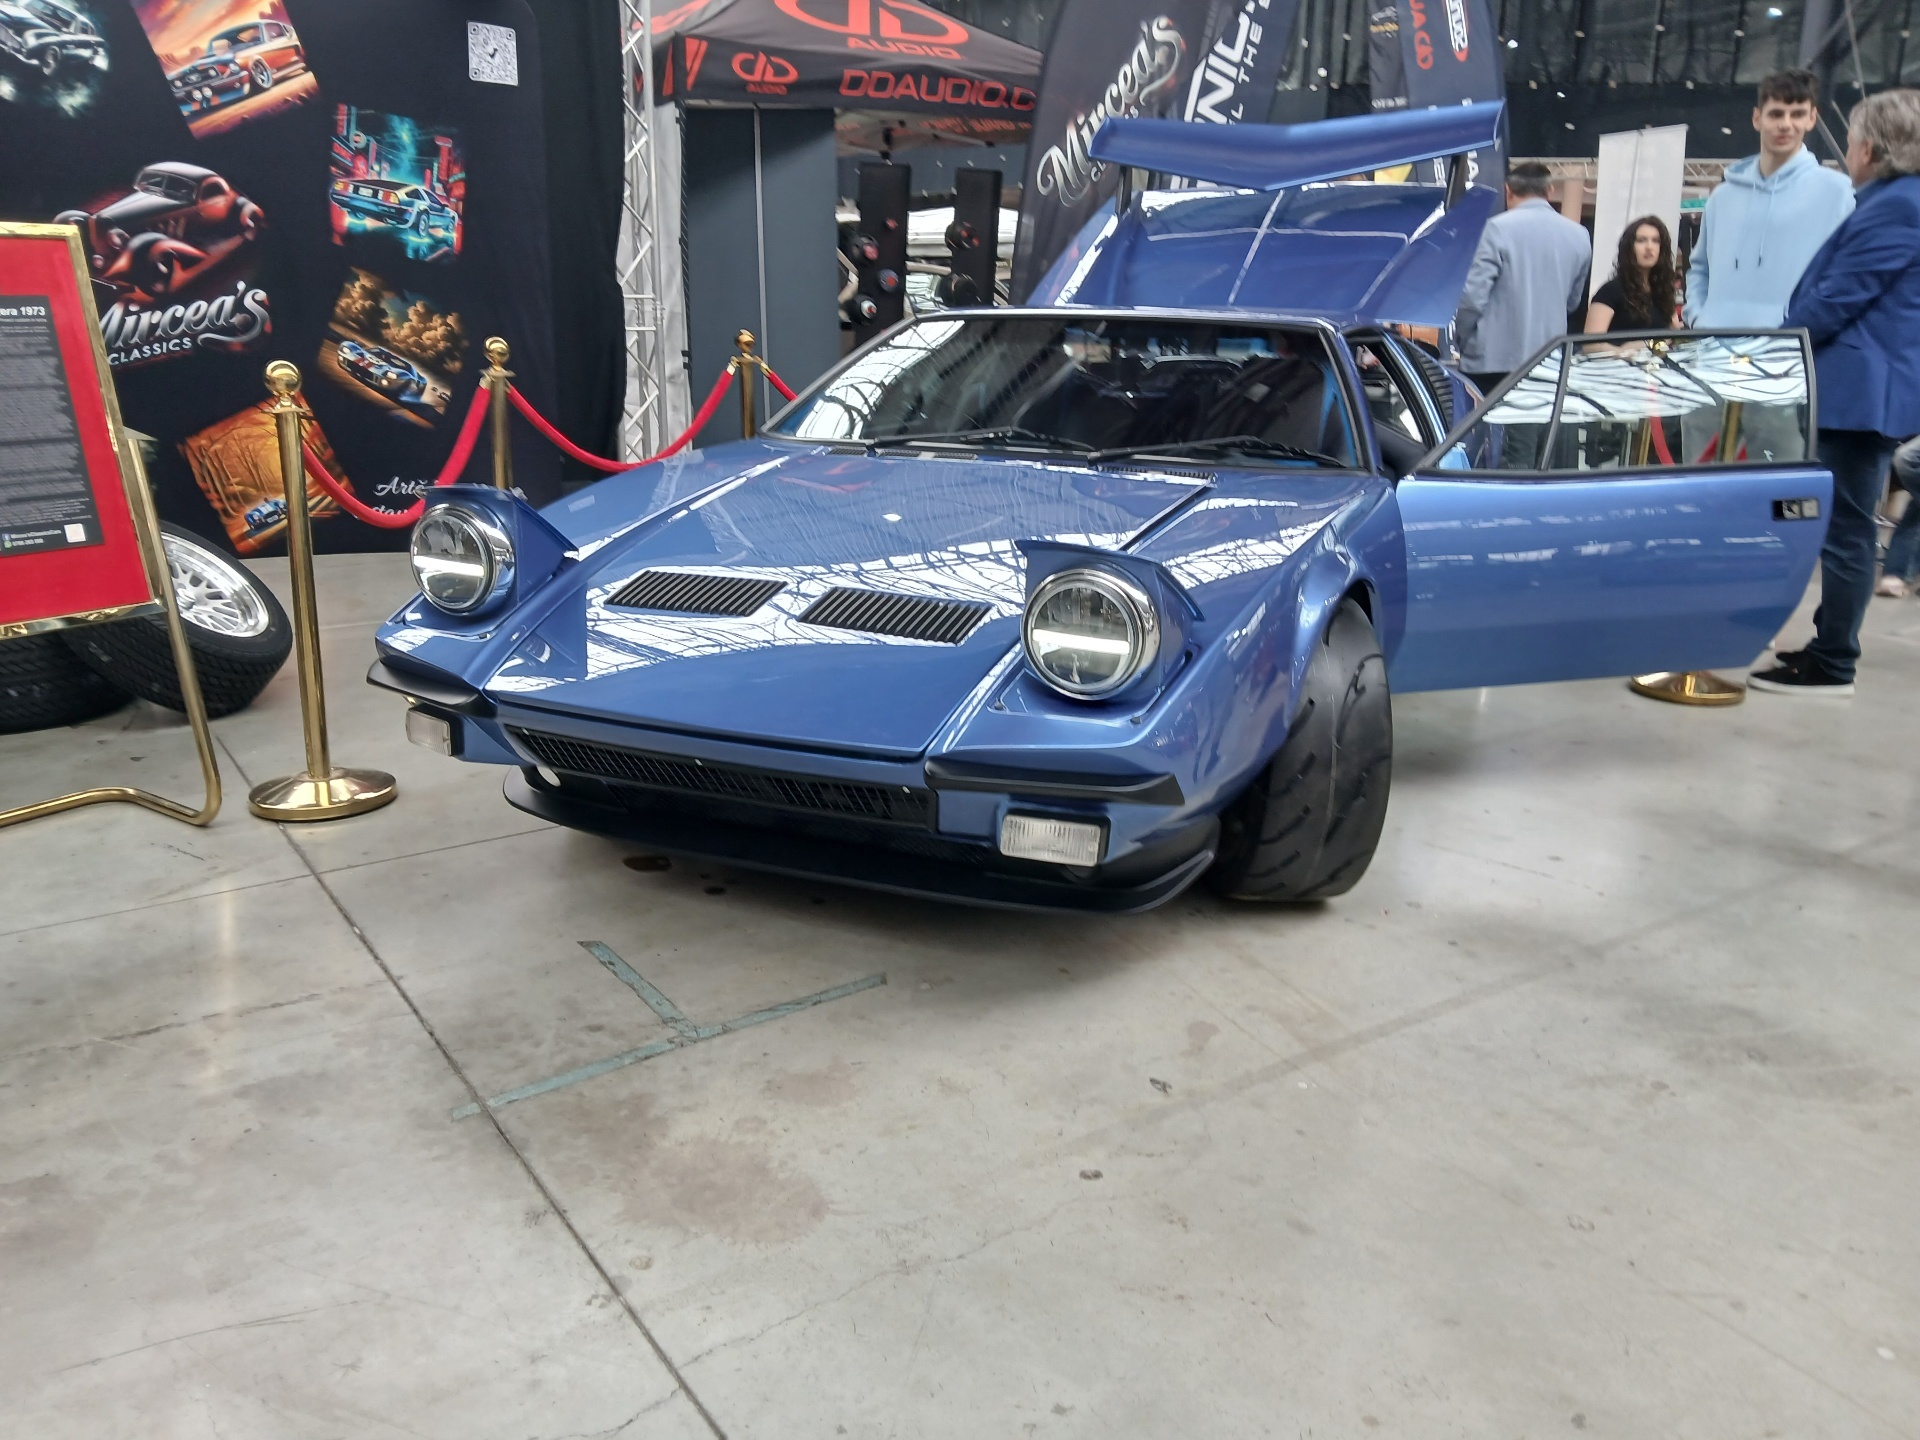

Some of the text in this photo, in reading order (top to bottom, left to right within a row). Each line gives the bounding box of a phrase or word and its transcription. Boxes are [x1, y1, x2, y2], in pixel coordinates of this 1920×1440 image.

[846, 37, 962, 60] AUDIO
[1237, 21, 1263, 84] THE
[20, 306, 45, 316] 1973
[108, 337, 192, 366] CLASSICS
